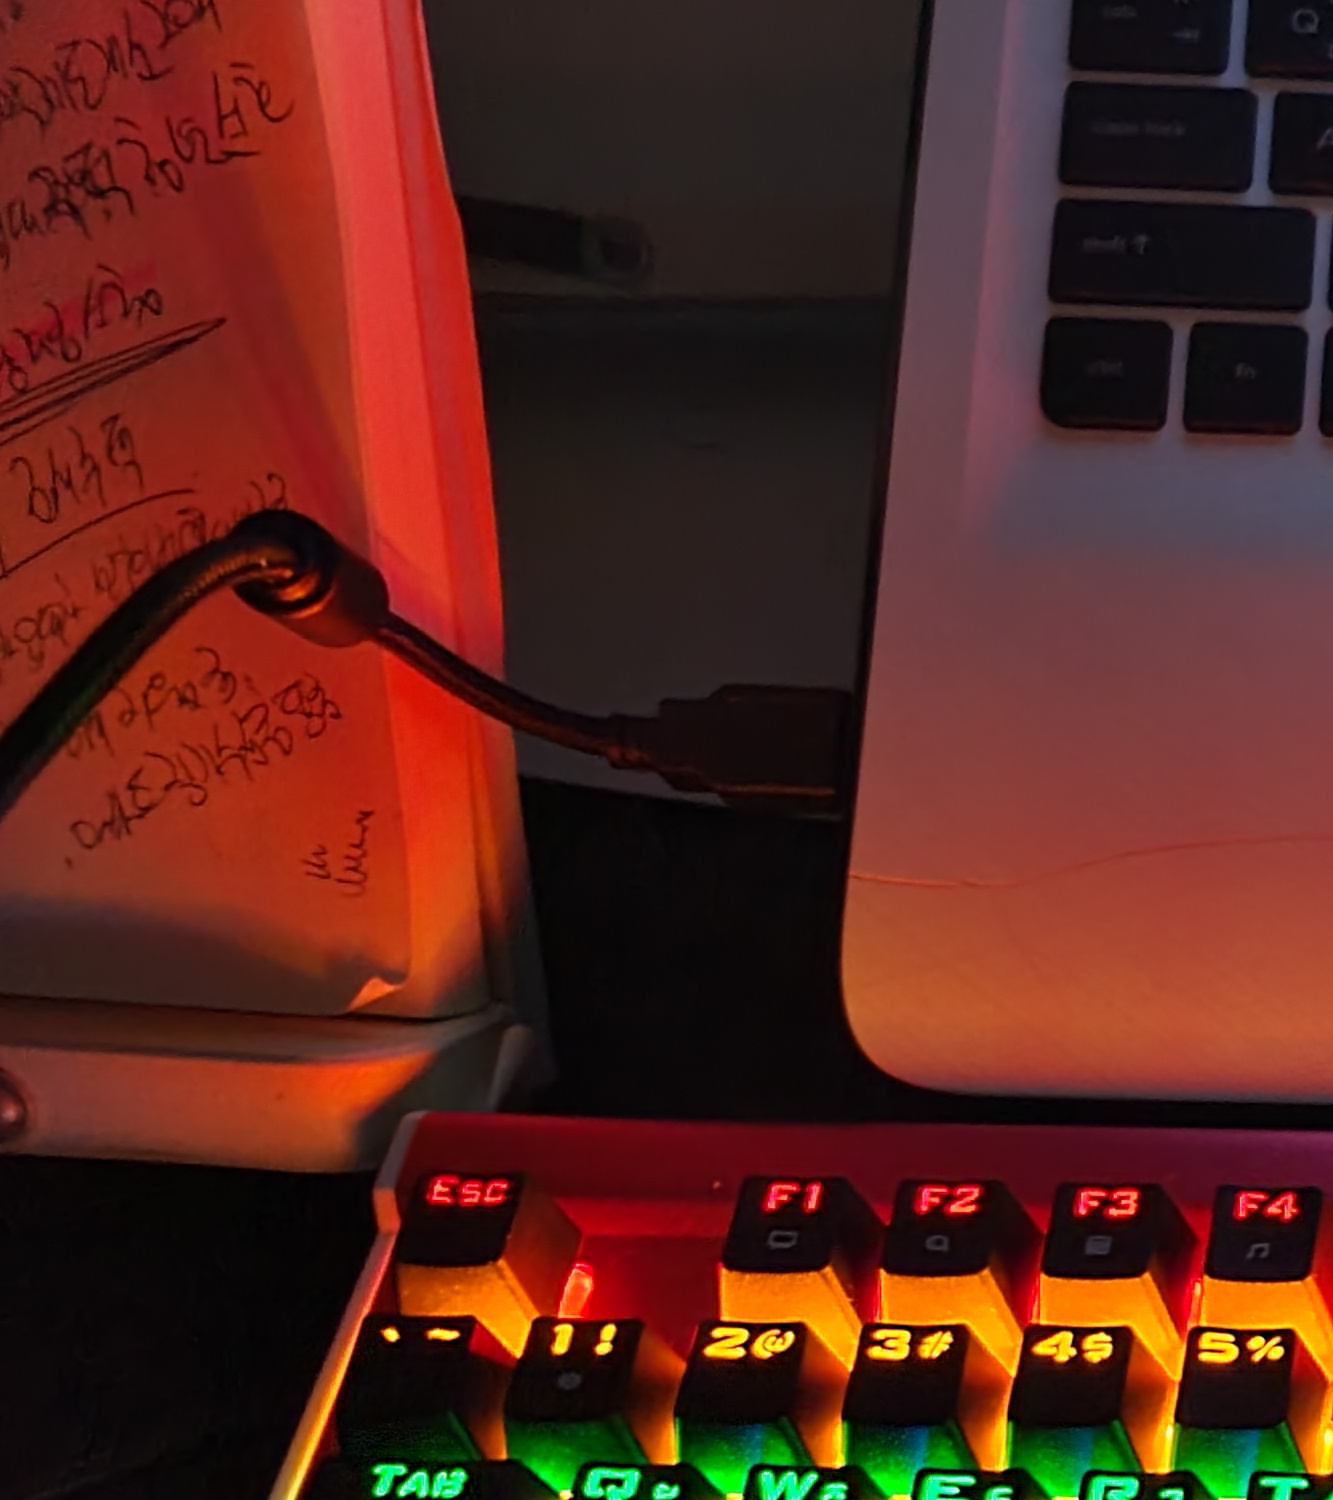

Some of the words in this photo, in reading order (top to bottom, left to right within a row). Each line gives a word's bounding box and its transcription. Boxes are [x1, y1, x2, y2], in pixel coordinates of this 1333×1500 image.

[1293, 8, 1320, 36] Q
[764, 1182, 823, 1212] F1
[914, 1186, 981, 1215] F2
[1072, 1188, 1141, 1217] F3
[1233, 1189, 1299, 1222] F4
[550, 1325, 571, 1354] 1
[581, 1468, 641, 1500] Q
[758, 1469, 819, 1500] W
